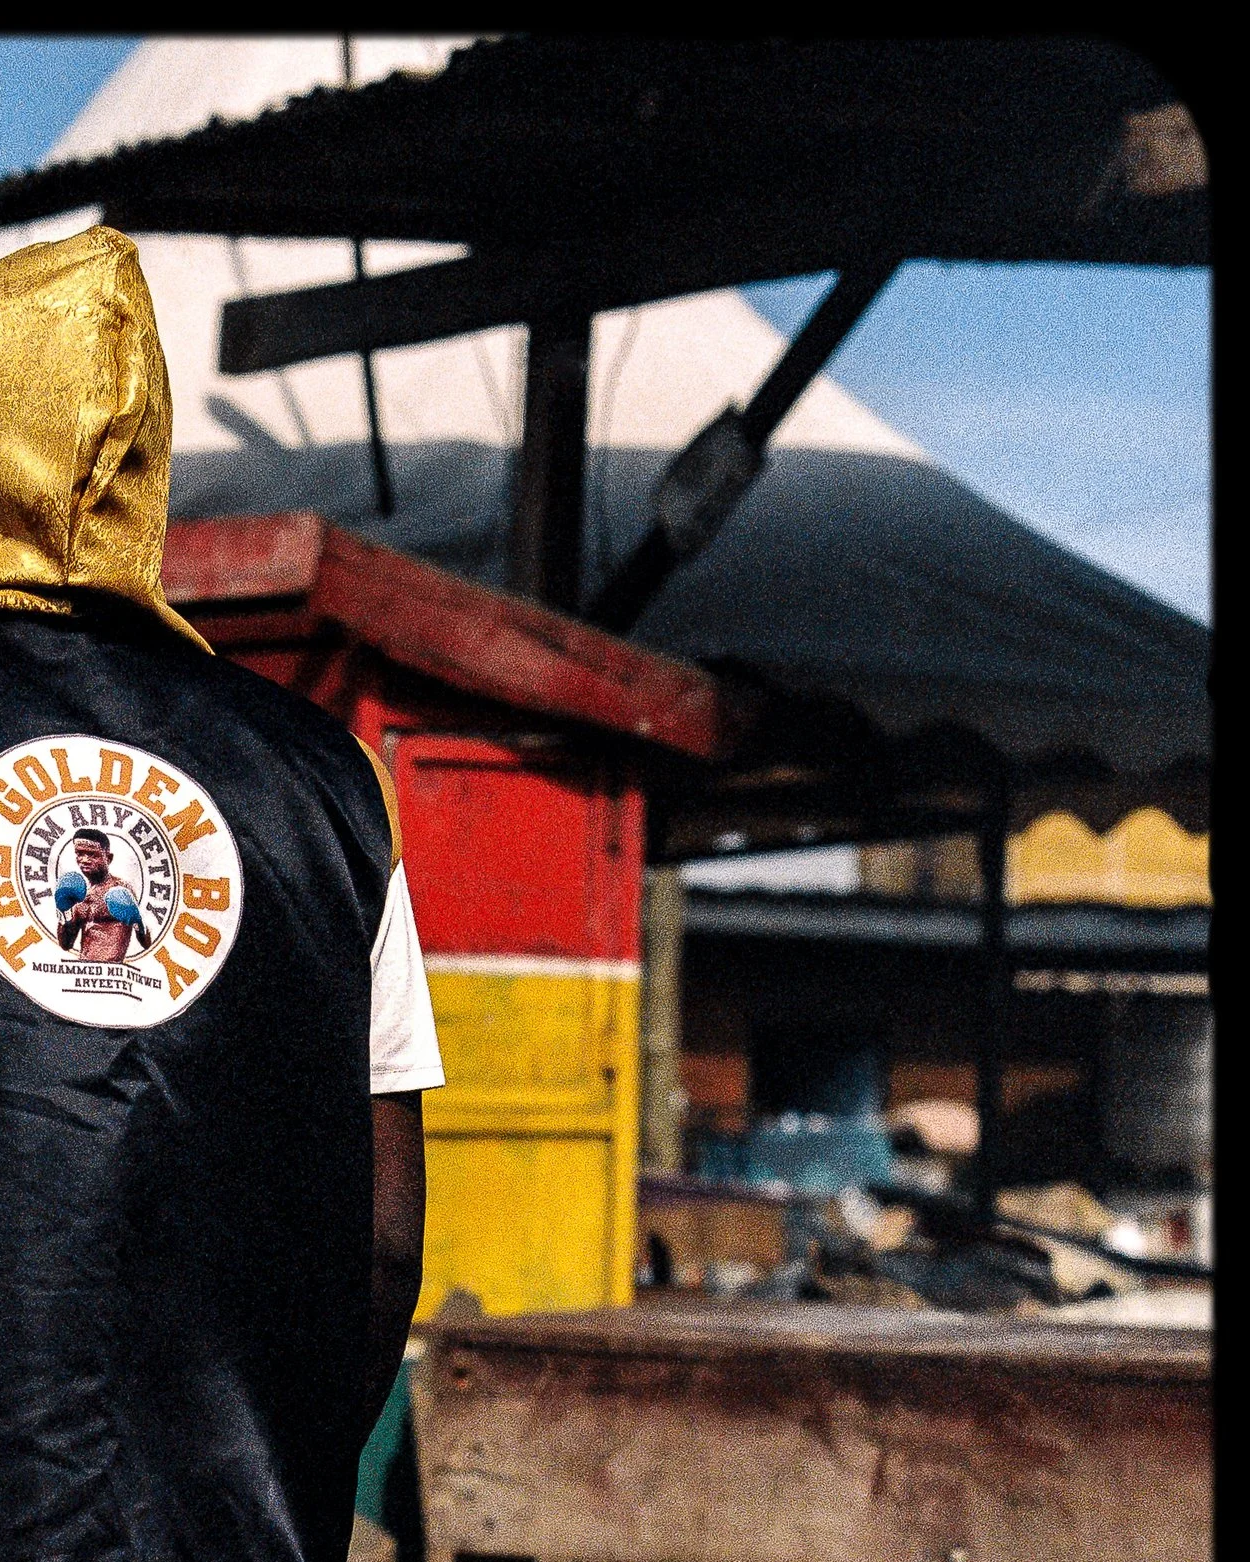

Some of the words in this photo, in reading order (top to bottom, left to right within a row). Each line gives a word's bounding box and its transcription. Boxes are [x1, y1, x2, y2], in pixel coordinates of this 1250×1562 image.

[24, 815, 64, 906] TEAM
[68, 803, 171, 925] ARYEETEY
[32, 961, 103, 976] MOHAMMED
[107, 966, 123, 977] NII
[154, 873, 230, 1000] BOY
[75, 978, 133, 992] ARYEETEY
